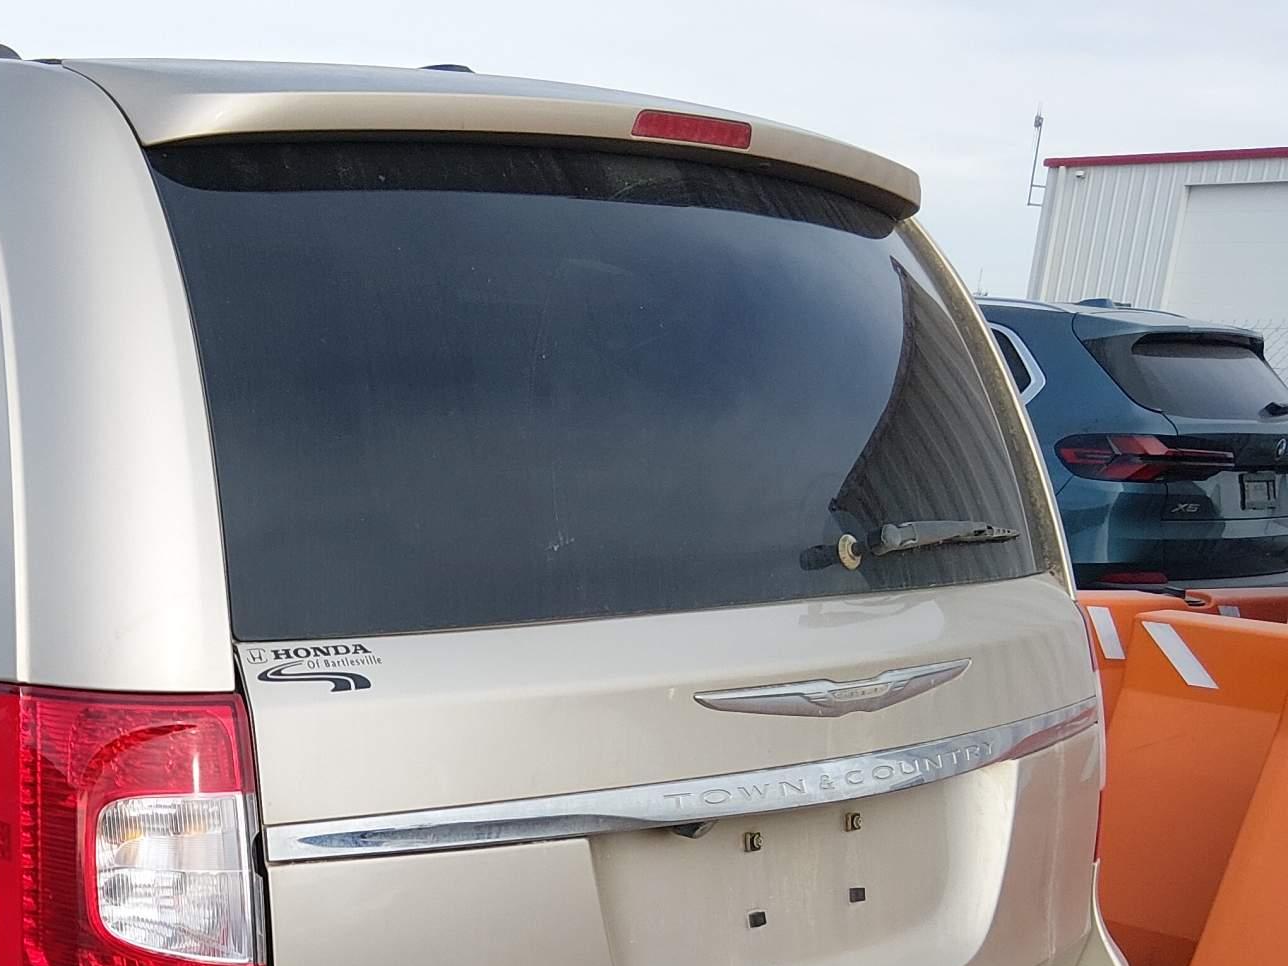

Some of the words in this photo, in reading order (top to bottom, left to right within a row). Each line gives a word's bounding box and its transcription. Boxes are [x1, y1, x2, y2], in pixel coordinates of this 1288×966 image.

[1171, 503, 1201, 513] X5
[271, 643, 372, 661] HONDA
[307, 659, 321, 670] Of
[324, 655, 383, 669] Bartlesville
[662, 778, 808, 810] TOWN
[845, 741, 995, 786] COUNTRY
